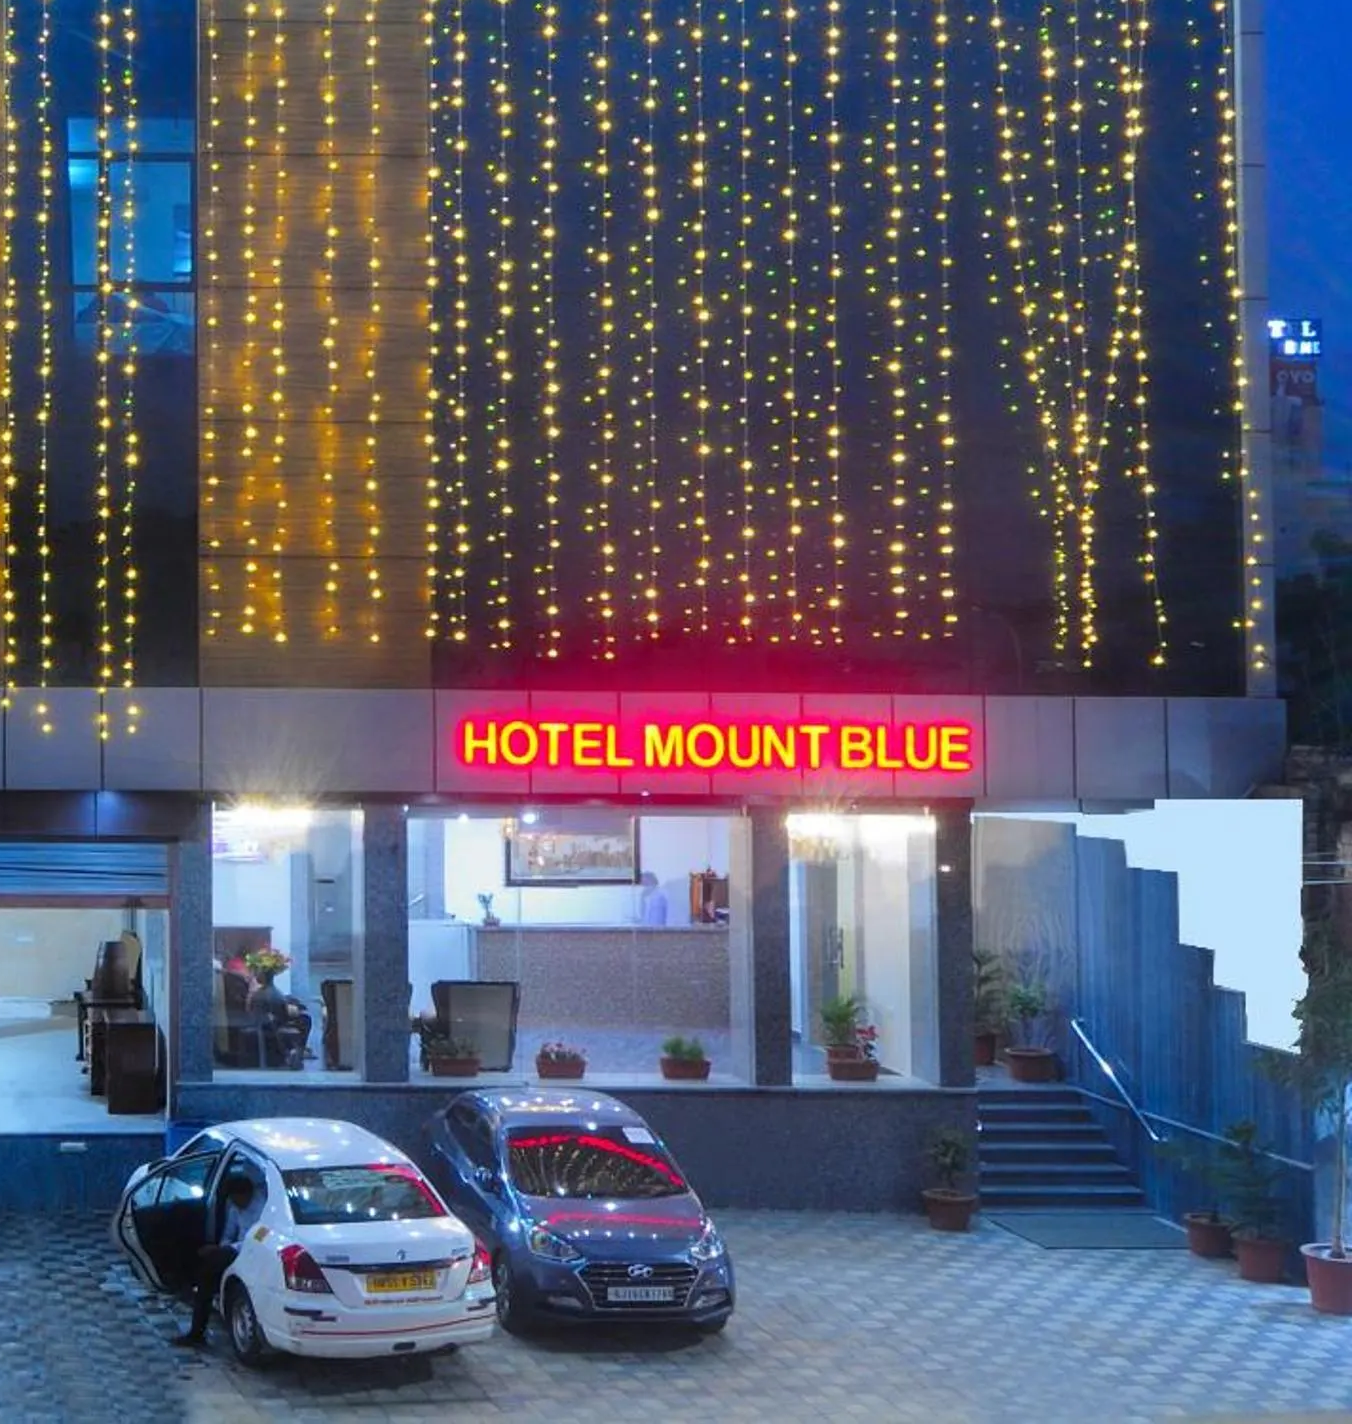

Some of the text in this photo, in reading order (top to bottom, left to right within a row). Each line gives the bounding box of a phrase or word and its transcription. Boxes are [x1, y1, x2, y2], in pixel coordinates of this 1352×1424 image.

[463, 721, 969, 769] HOTEL MOUNT BLUE
